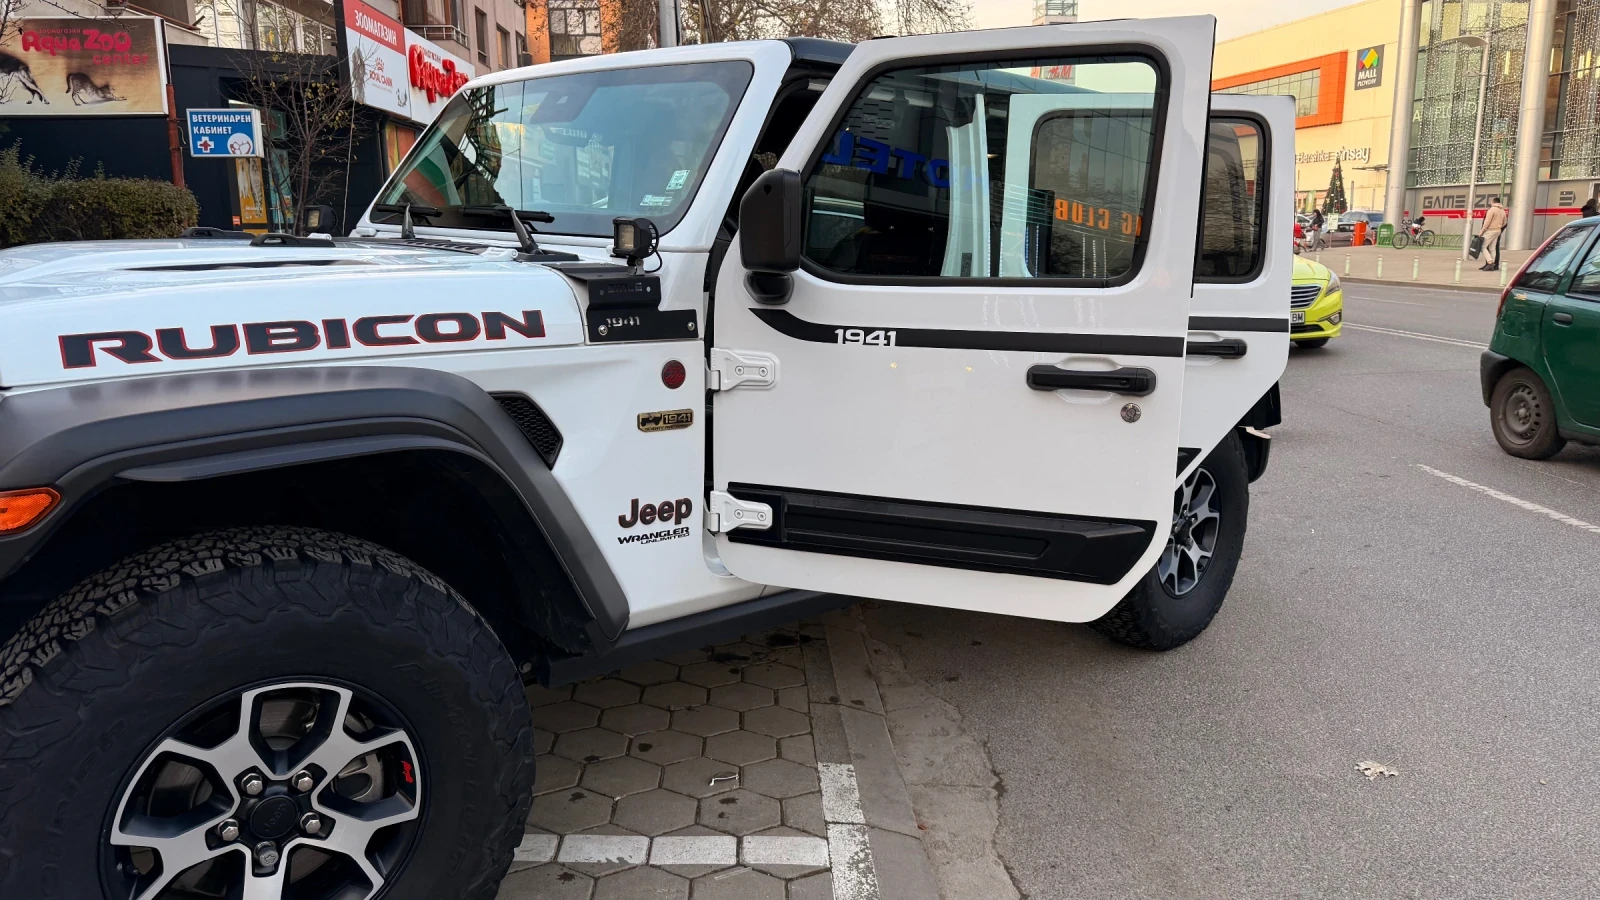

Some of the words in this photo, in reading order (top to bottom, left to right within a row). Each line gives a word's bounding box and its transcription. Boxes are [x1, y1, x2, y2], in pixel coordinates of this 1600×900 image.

[354, 9, 397, 46] ЗООМАГАЗИН
[92, 53, 149, 66] center
[1357, 68, 1377, 80] MALL
[1357, 78, 1377, 87] PLOVDIV
[192, 114, 251, 123] ВЕТЕРИНАРЕН
[193, 126, 232, 134] КАБИНЕТ
[1423, 194, 1466, 209] GAME
[605, 315, 640, 328] 1941
[58, 310, 547, 369] RUBICON
[834, 328, 897, 347] 1941
[664, 413, 691, 424] 1941
[618, 497, 693, 529] Jeep
[617, 526, 690, 545] WRANGLER
[640, 532, 690, 545] UNLIMITED
